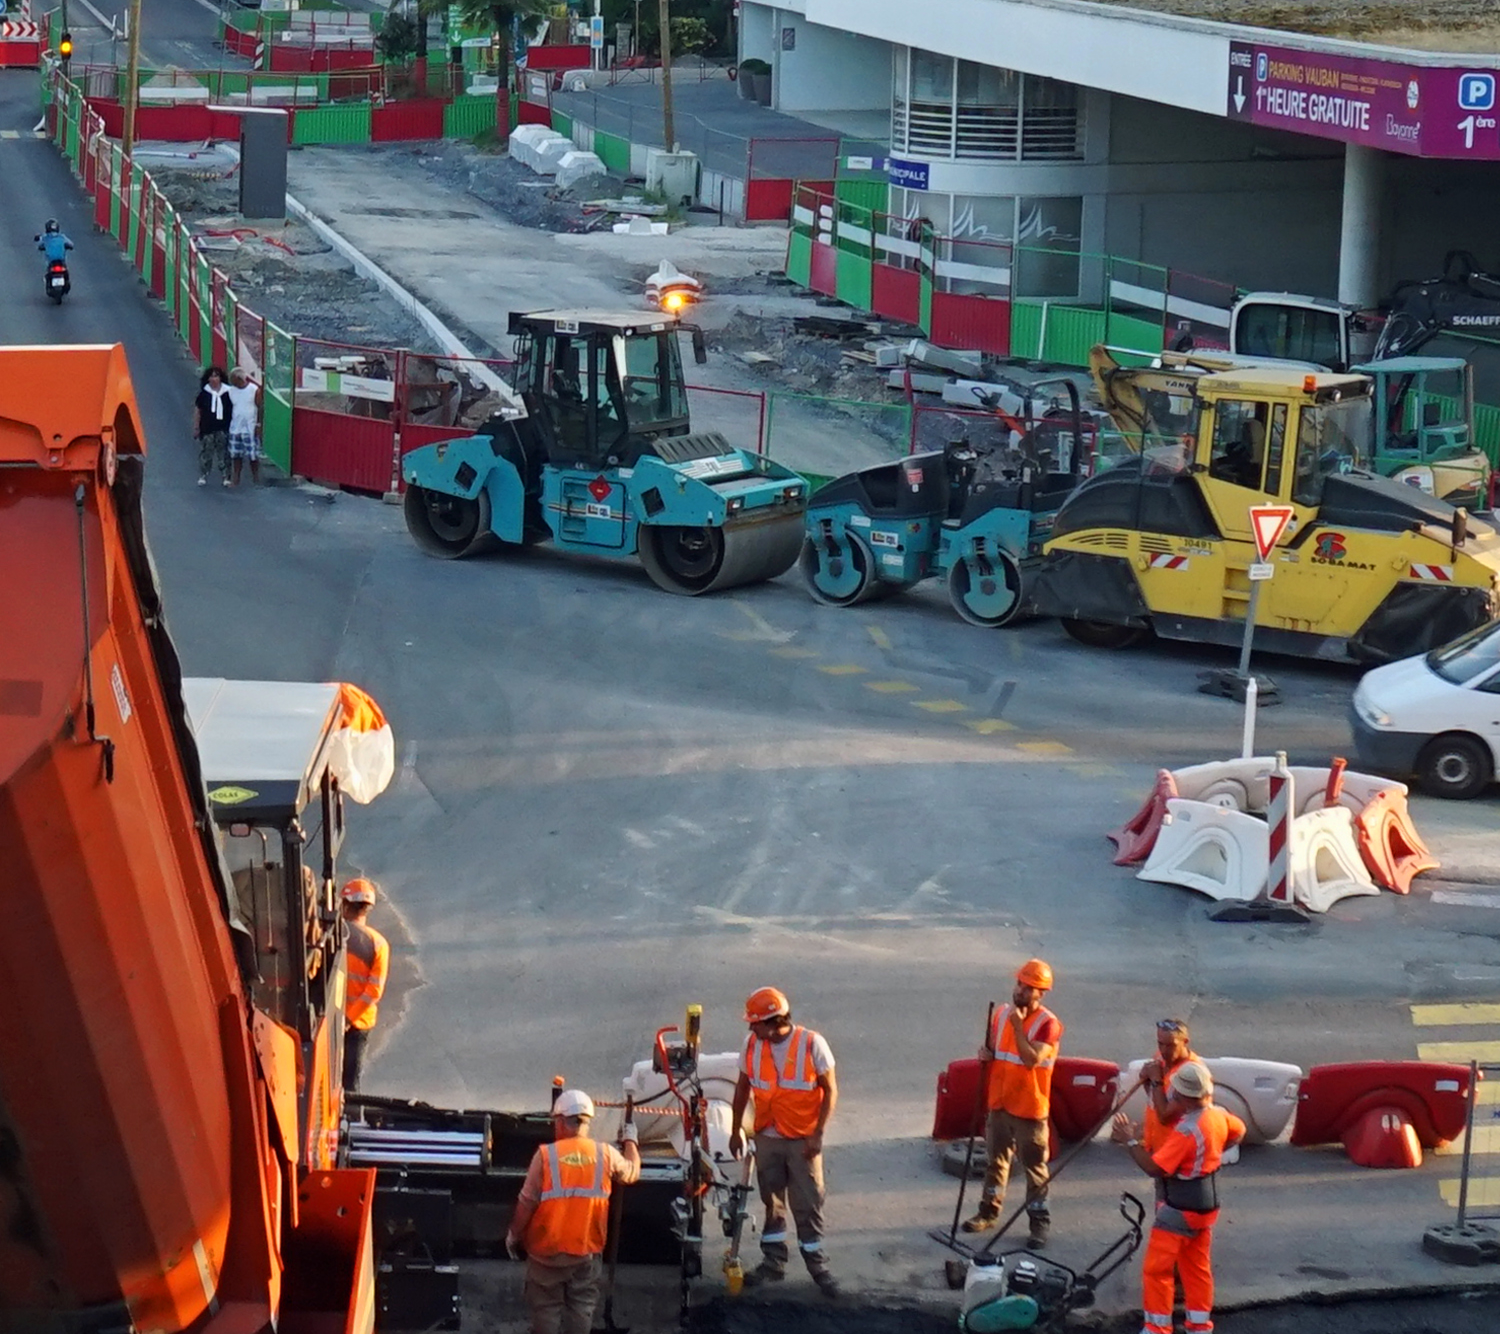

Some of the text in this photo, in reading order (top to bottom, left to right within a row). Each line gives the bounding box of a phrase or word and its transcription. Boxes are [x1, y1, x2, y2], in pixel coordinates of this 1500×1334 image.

[1268, 61, 1304, 84] PARKING
[1305, 66, 1340, 89] VAUBAN
[1267, 88, 1307, 119] HEURE
[1308, 93, 1371, 131] GRATUITE
[1457, 114, 1496, 149] 1ère
[213, 791, 238, 799] COLAS
